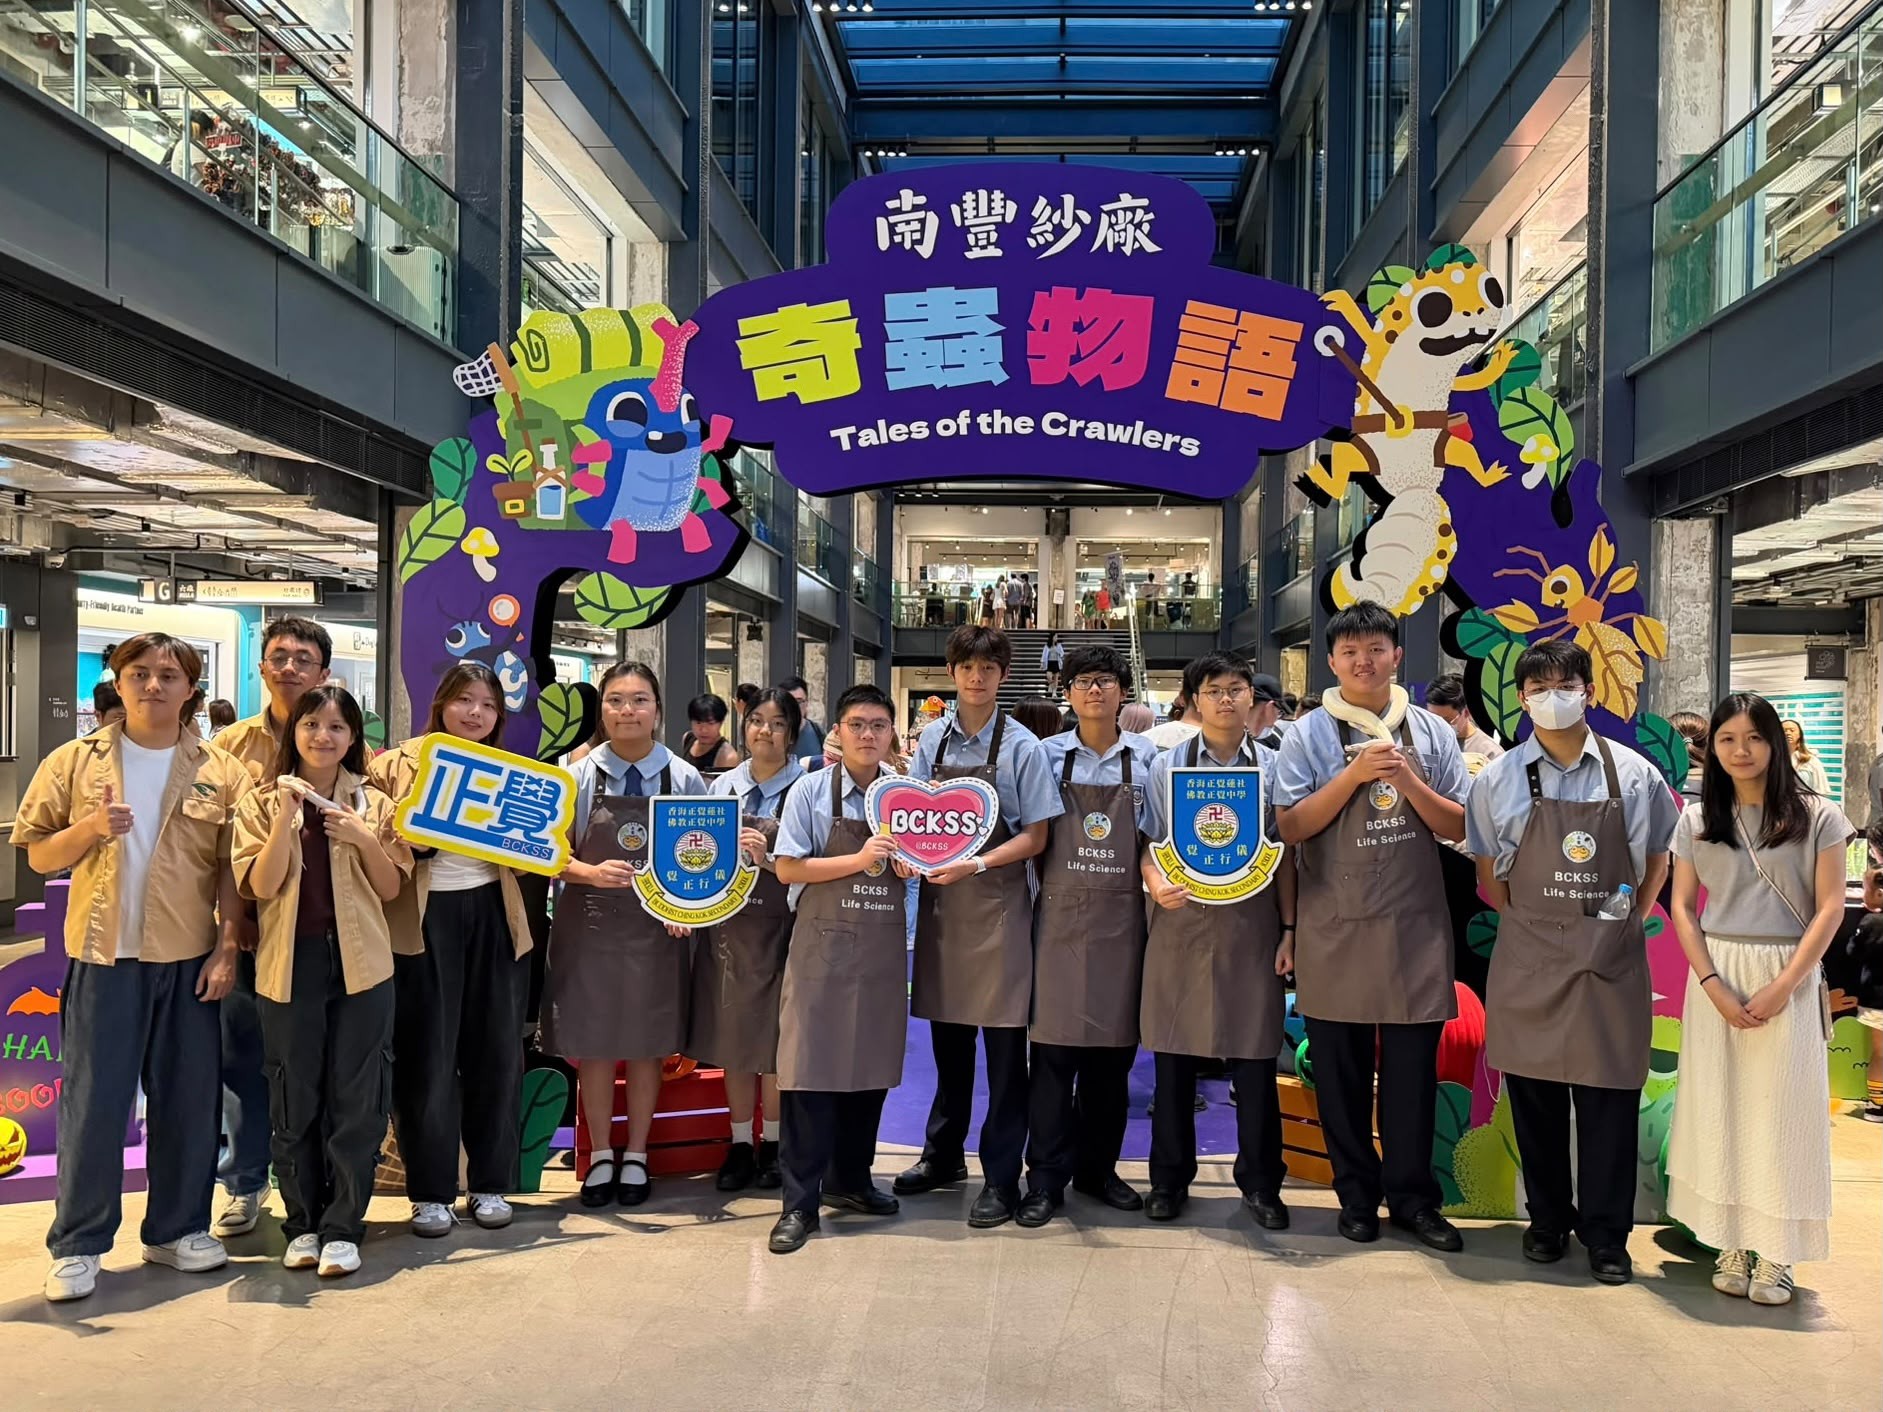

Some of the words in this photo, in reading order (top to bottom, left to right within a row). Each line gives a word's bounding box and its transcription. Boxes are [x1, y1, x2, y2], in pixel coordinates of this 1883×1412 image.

[875, 189, 1163, 260] 南豐紗廠
[735, 286, 1304, 422] 奇蟲物語
[830, 419, 930, 451] Tales
[936, 410, 971, 435] of
[977, 409, 1035, 434] the
[1041, 412, 1201, 457] Crawlers
[410, 749, 562, 860] 正覺
[890, 809, 978, 836] BCKSS
[1365, 815, 1406, 830] BCKSS
[1356, 838, 1377, 847] Life
[1380, 831, 1416, 844] Science
[501, 837, 551, 860] BCKSS
[1078, 847, 1115, 858] BCKSS
[1067, 861, 1086, 871] Life
[1088, 863, 1126, 874] Science
[1554, 871, 1599, 883] BCKSS
[852, 884, 888, 896] BCKSS
[1543, 887, 1565, 897] Life
[1568, 889, 1610, 899] Science
[841, 898, 860, 909] Life
[863, 900, 895, 911] Science
[3, 1033, 63, 1062] HA
